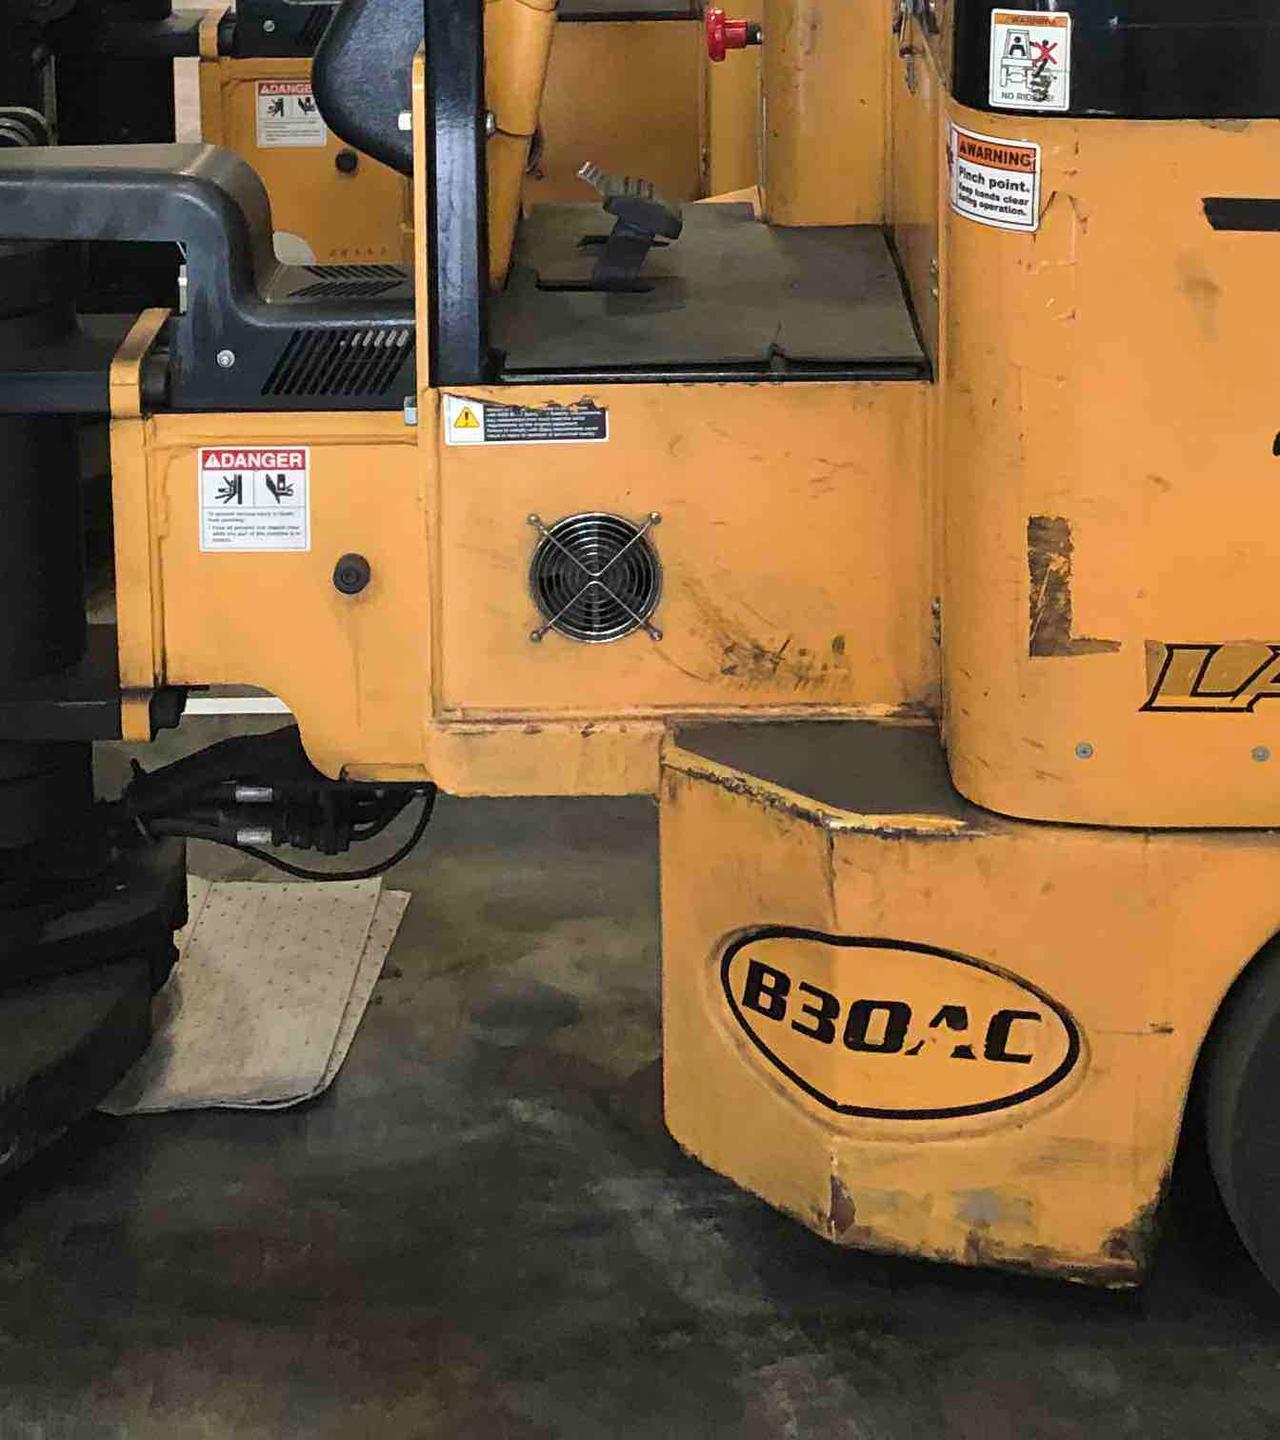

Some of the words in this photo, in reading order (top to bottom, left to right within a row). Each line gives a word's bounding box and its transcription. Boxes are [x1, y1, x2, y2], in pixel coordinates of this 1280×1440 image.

[967, 144, 1032, 167] WARNING
[959, 166, 985, 185] Pinch
[989, 178, 1030, 192] point.
[1003, 195, 1030, 206] clear
[221, 453, 303, 468] DANGER
